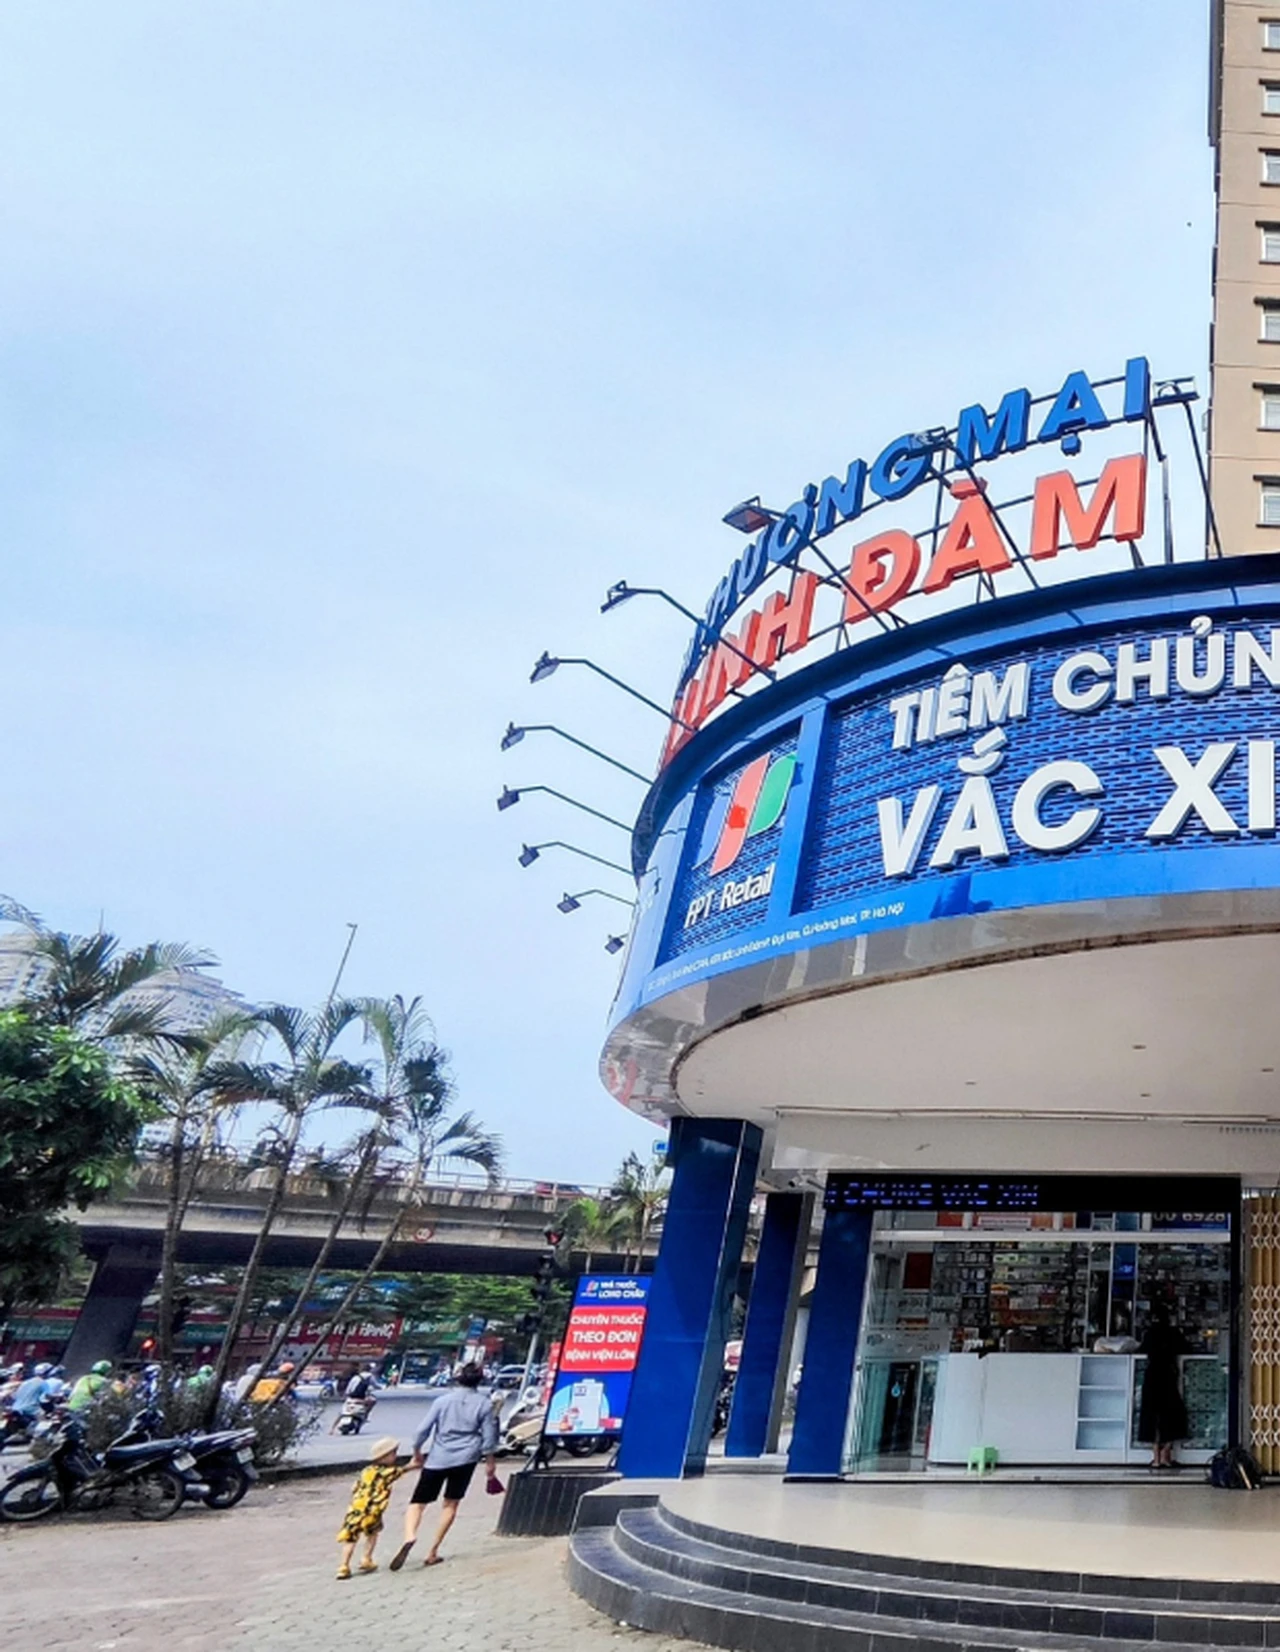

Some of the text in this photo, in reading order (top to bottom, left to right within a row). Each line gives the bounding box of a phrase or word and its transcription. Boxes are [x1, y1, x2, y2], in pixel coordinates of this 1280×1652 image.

[954, 357, 1150, 467] MẠI
[842, 454, 1147, 624] ĐÀM
[889, 663, 1031, 752] TIÊM
[876, 726, 1105, 878] VẮC
[720, 862, 777, 911] Retail
[573, 1331, 606, 1343] THEO
